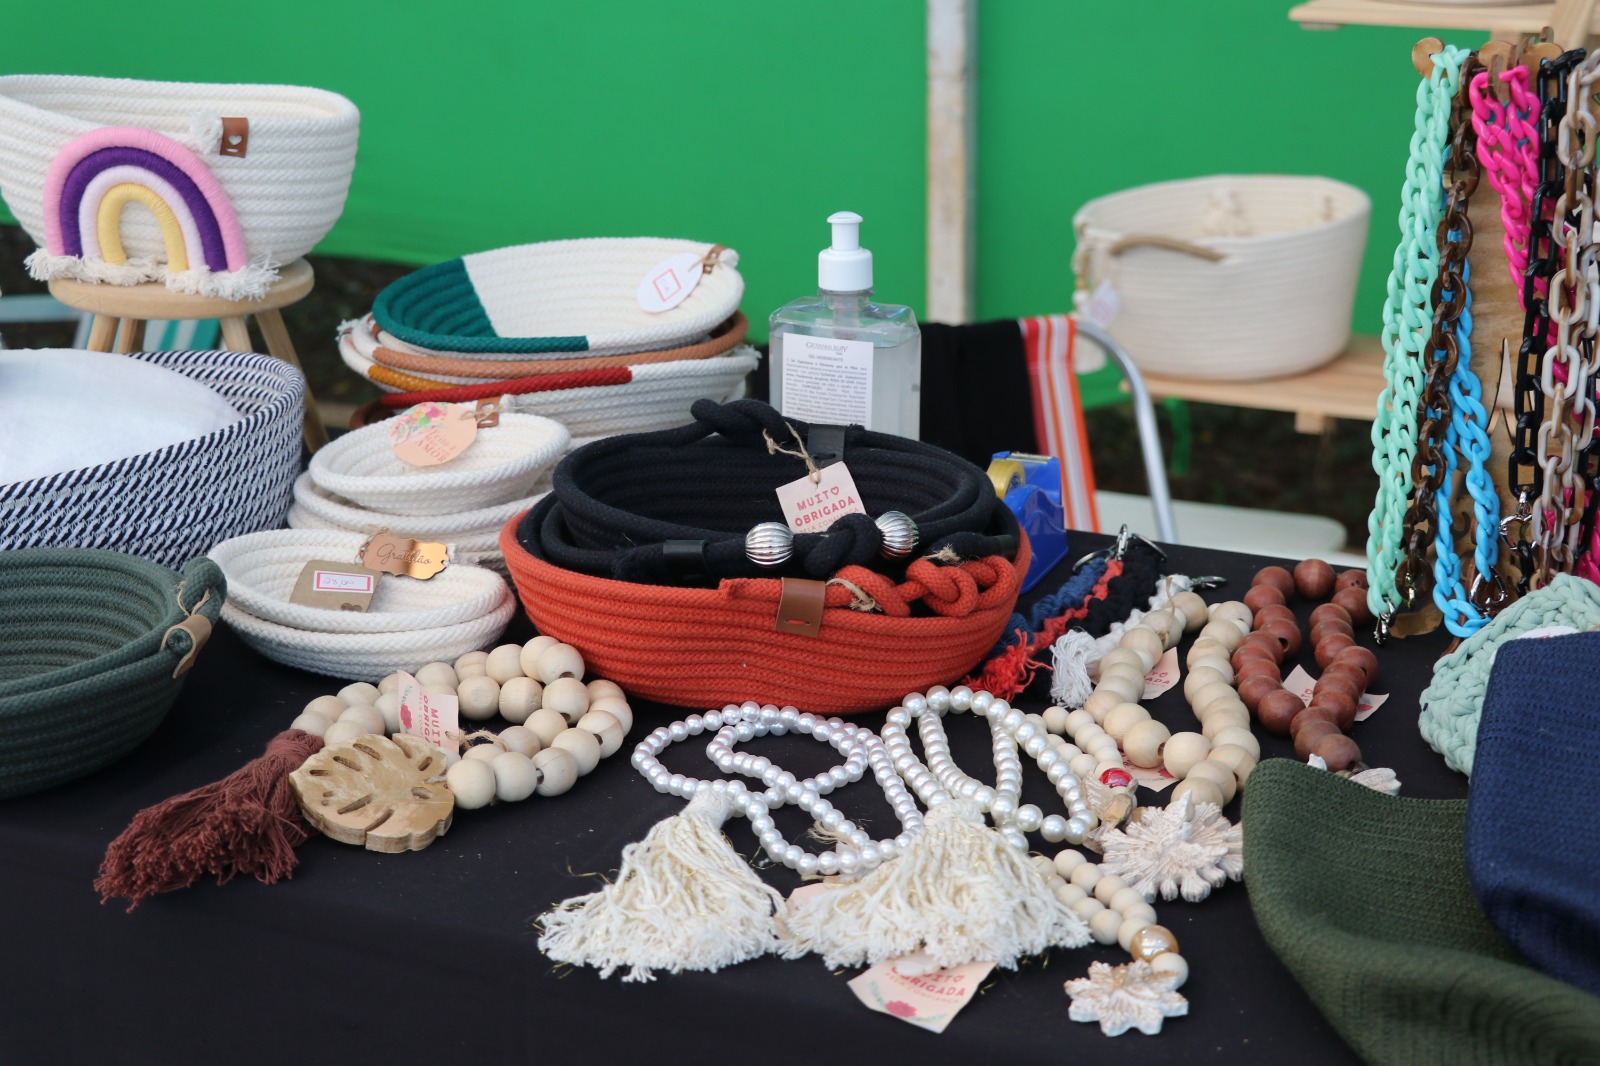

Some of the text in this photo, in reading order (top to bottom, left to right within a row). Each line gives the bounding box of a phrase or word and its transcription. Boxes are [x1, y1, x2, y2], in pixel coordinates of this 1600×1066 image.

[418, 440, 447, 462] AMOR
[795, 496, 855, 526] OBRIGADA
[377, 543, 432, 564] Gratidão
[431, 708, 440, 747] MUIT
